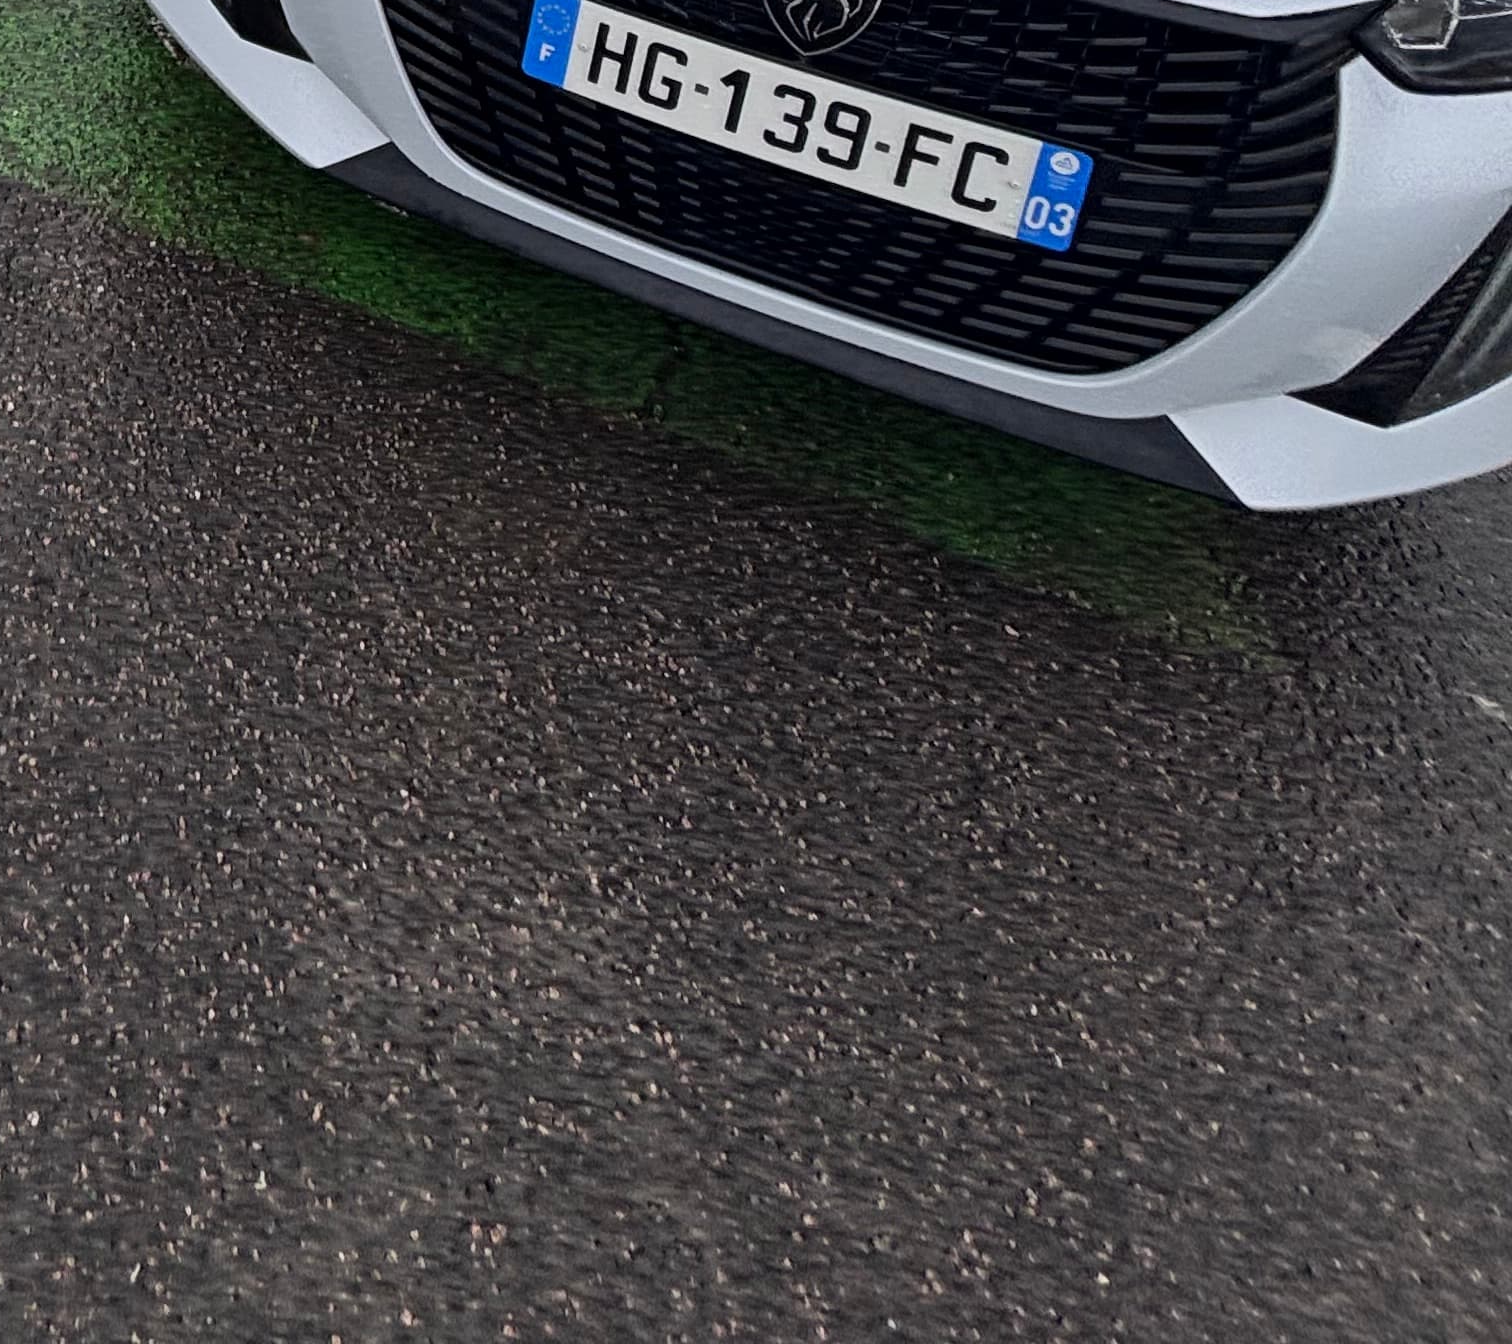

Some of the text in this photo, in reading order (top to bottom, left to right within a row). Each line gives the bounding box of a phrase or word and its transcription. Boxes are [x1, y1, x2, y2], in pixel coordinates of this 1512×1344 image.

[538, 42, 556, 62] F
[587, 22, 1010, 213] HG-139-FC
[1024, 195, 1076, 237] 03
